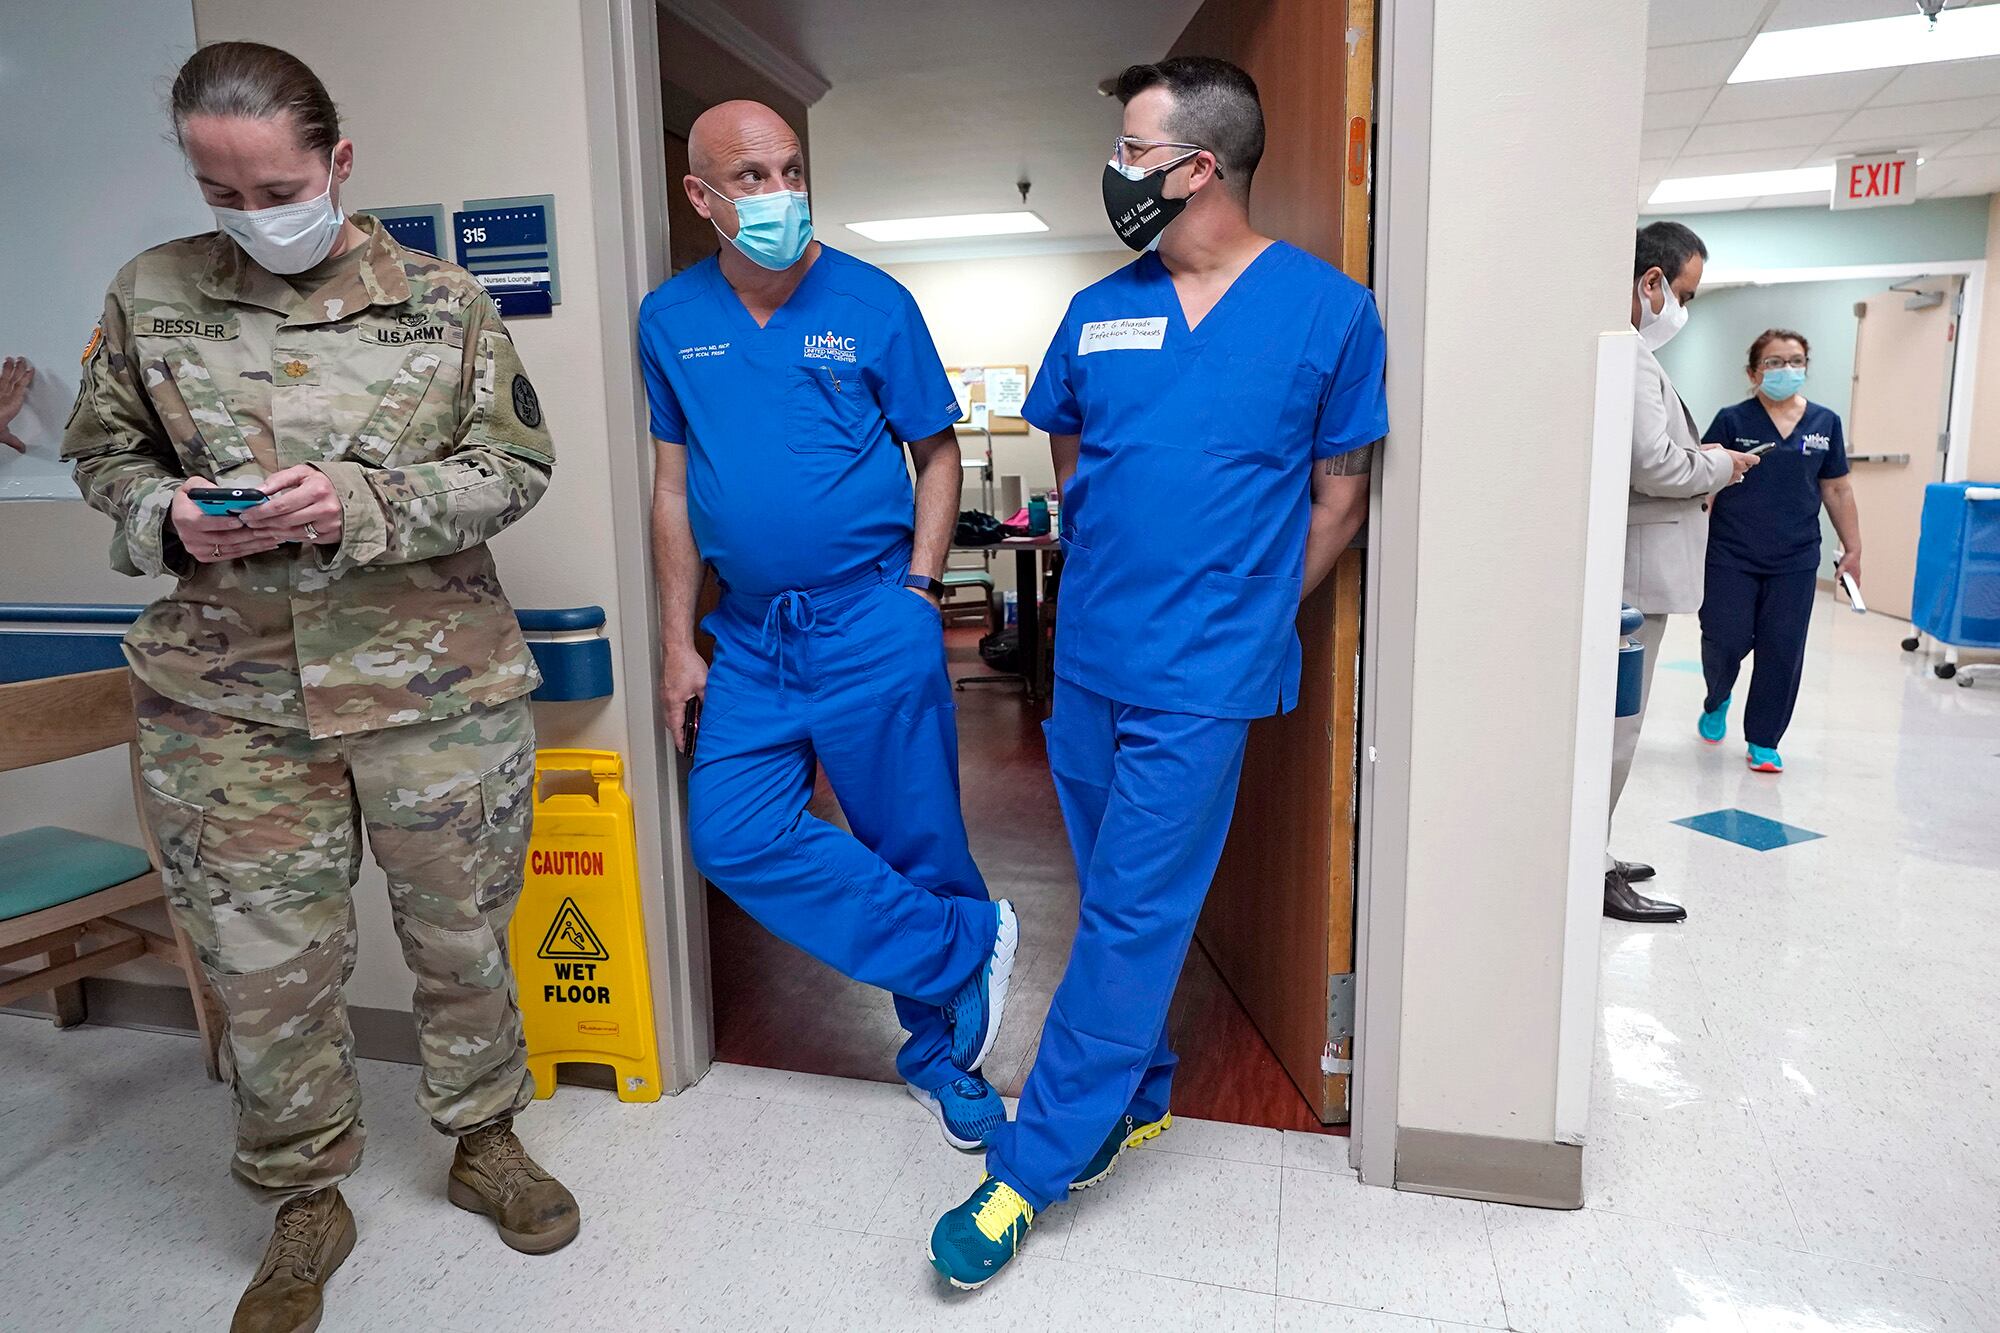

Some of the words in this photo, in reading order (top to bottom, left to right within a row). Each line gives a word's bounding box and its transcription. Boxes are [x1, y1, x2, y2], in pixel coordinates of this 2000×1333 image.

[1849, 161, 1905, 199] EXIT
[463, 227, 487, 243] 315
[484, 276, 507, 284] Nurses
[508, 275, 532, 284] Lounge
[153, 318, 225, 338] BESSLER
[1120, 319, 1151, 328] Alvarado
[804, 334, 856, 351] UMMC
[1089, 330, 1128, 340] Infectious
[531, 850, 604, 876] CAUTION
[554, 963, 597, 981] WET
[544, 985, 611, 1005] FLOOR
